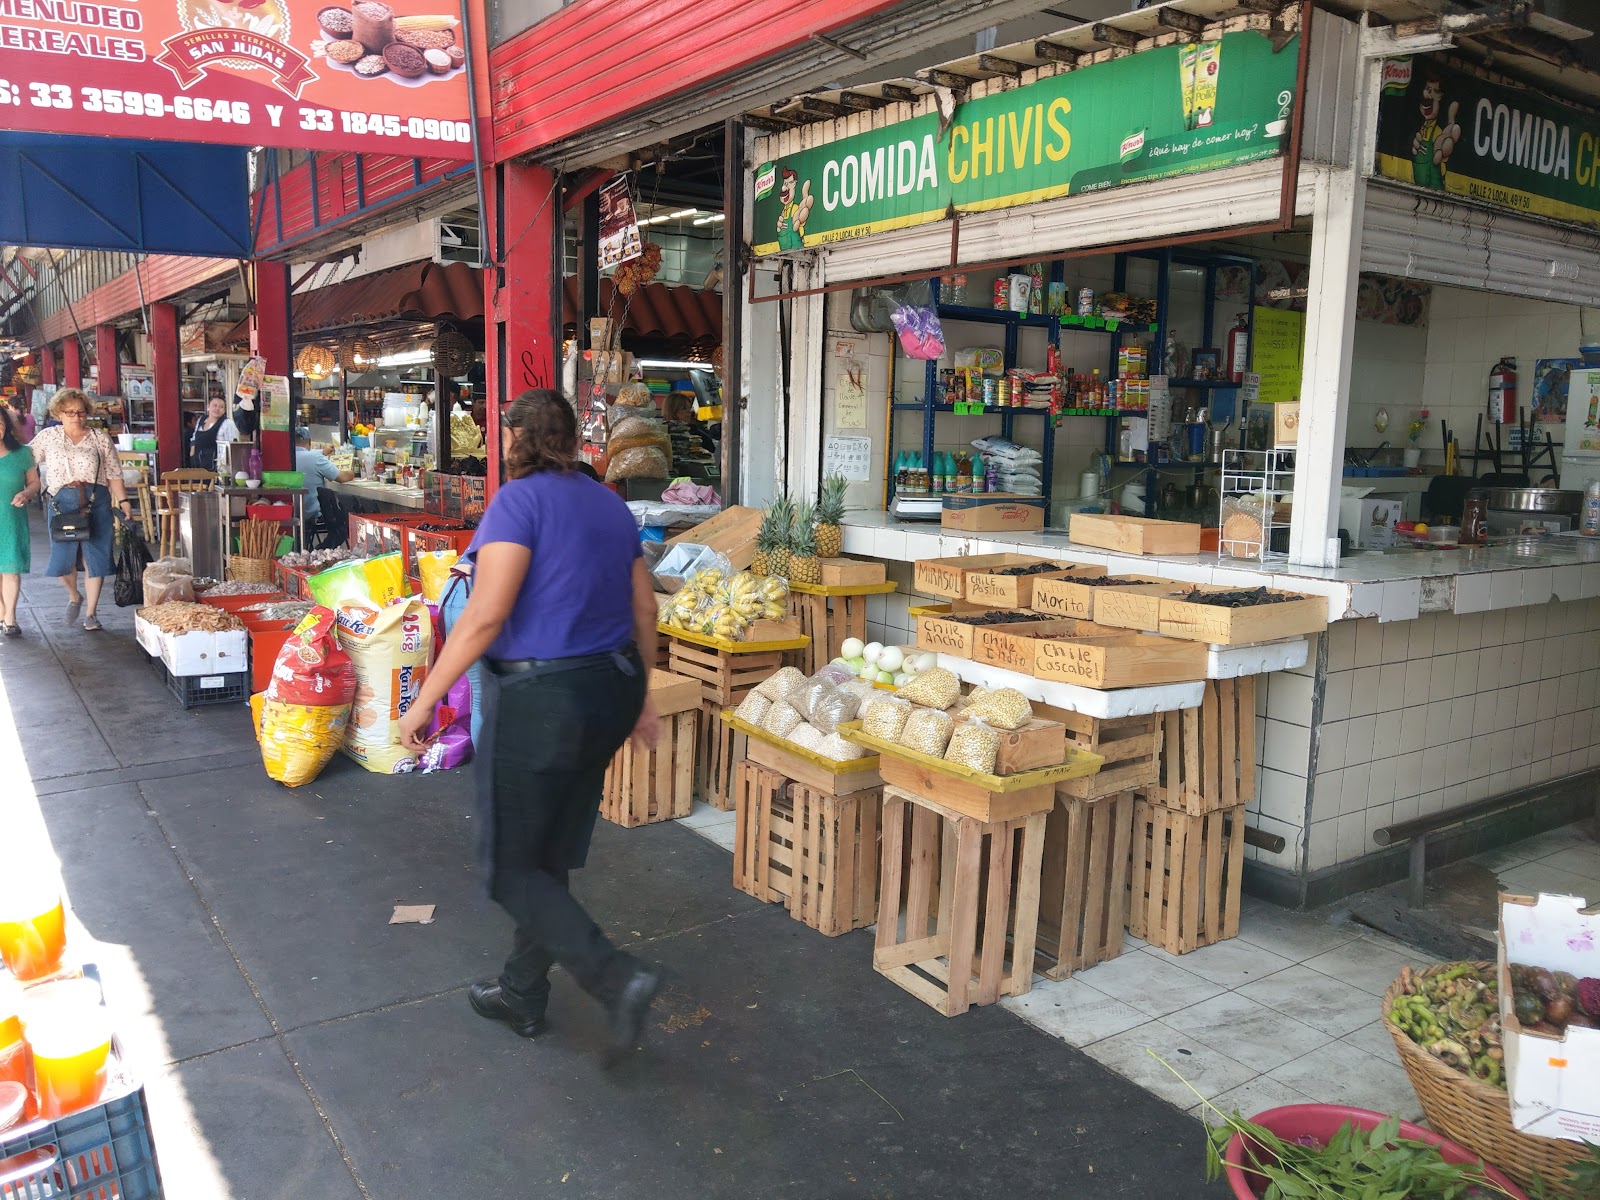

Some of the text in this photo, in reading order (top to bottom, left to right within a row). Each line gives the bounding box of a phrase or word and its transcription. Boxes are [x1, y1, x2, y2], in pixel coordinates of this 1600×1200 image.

[0, 25, 145, 62] EREALES
[184, 33, 229, 47] SEMILLAS
[241, 34, 287, 58] CEREALES
[189, 41, 286, 69] SAN JUDAS
[1384, 64, 1411, 79] Knorr
[1196, 91, 1215, 102] Pollo
[29, 82, 73, 109] 33
[81, 87, 251, 125] 3599-6646
[265, 104, 283, 128] Y
[299, 108, 334, 132] 33
[340, 111, 471, 143] 1845-0900
[1122, 137, 1144, 152] Knorr
[1149, 123, 1258, 157] ¿Qué hay de comer hoy?
[1474, 98, 1570, 181] COMIDA
[823, 97, 1072, 212] COMIDA CHIVIS
[756, 175, 775, 192] Knorr
[1081, 183, 1098, 192] COME
[1469, 183, 1487, 198] CALLE
[1487, 188, 1492, 198] 2
[1492, 189, 1510, 204] LOCAL
[1510, 194, 1518, 206] 49
[822, 232, 835, 243] CALLE
[840, 229, 854, 240] LOCAL
[918, 563, 960, 594] MIRASOL
[1041, 580, 1076, 597] Chile
[1038, 591, 1085, 613] Morita
[924, 620, 960, 636] Chile
[925, 633, 964, 650] Ancho
[983, 633, 1016, 653] Chile
[985, 647, 1026, 667] Indio
[1043, 643, 1092, 663] Chile
[1036, 656, 1100, 681] Cascabel
[398, 664, 413, 718] Kan Ka
